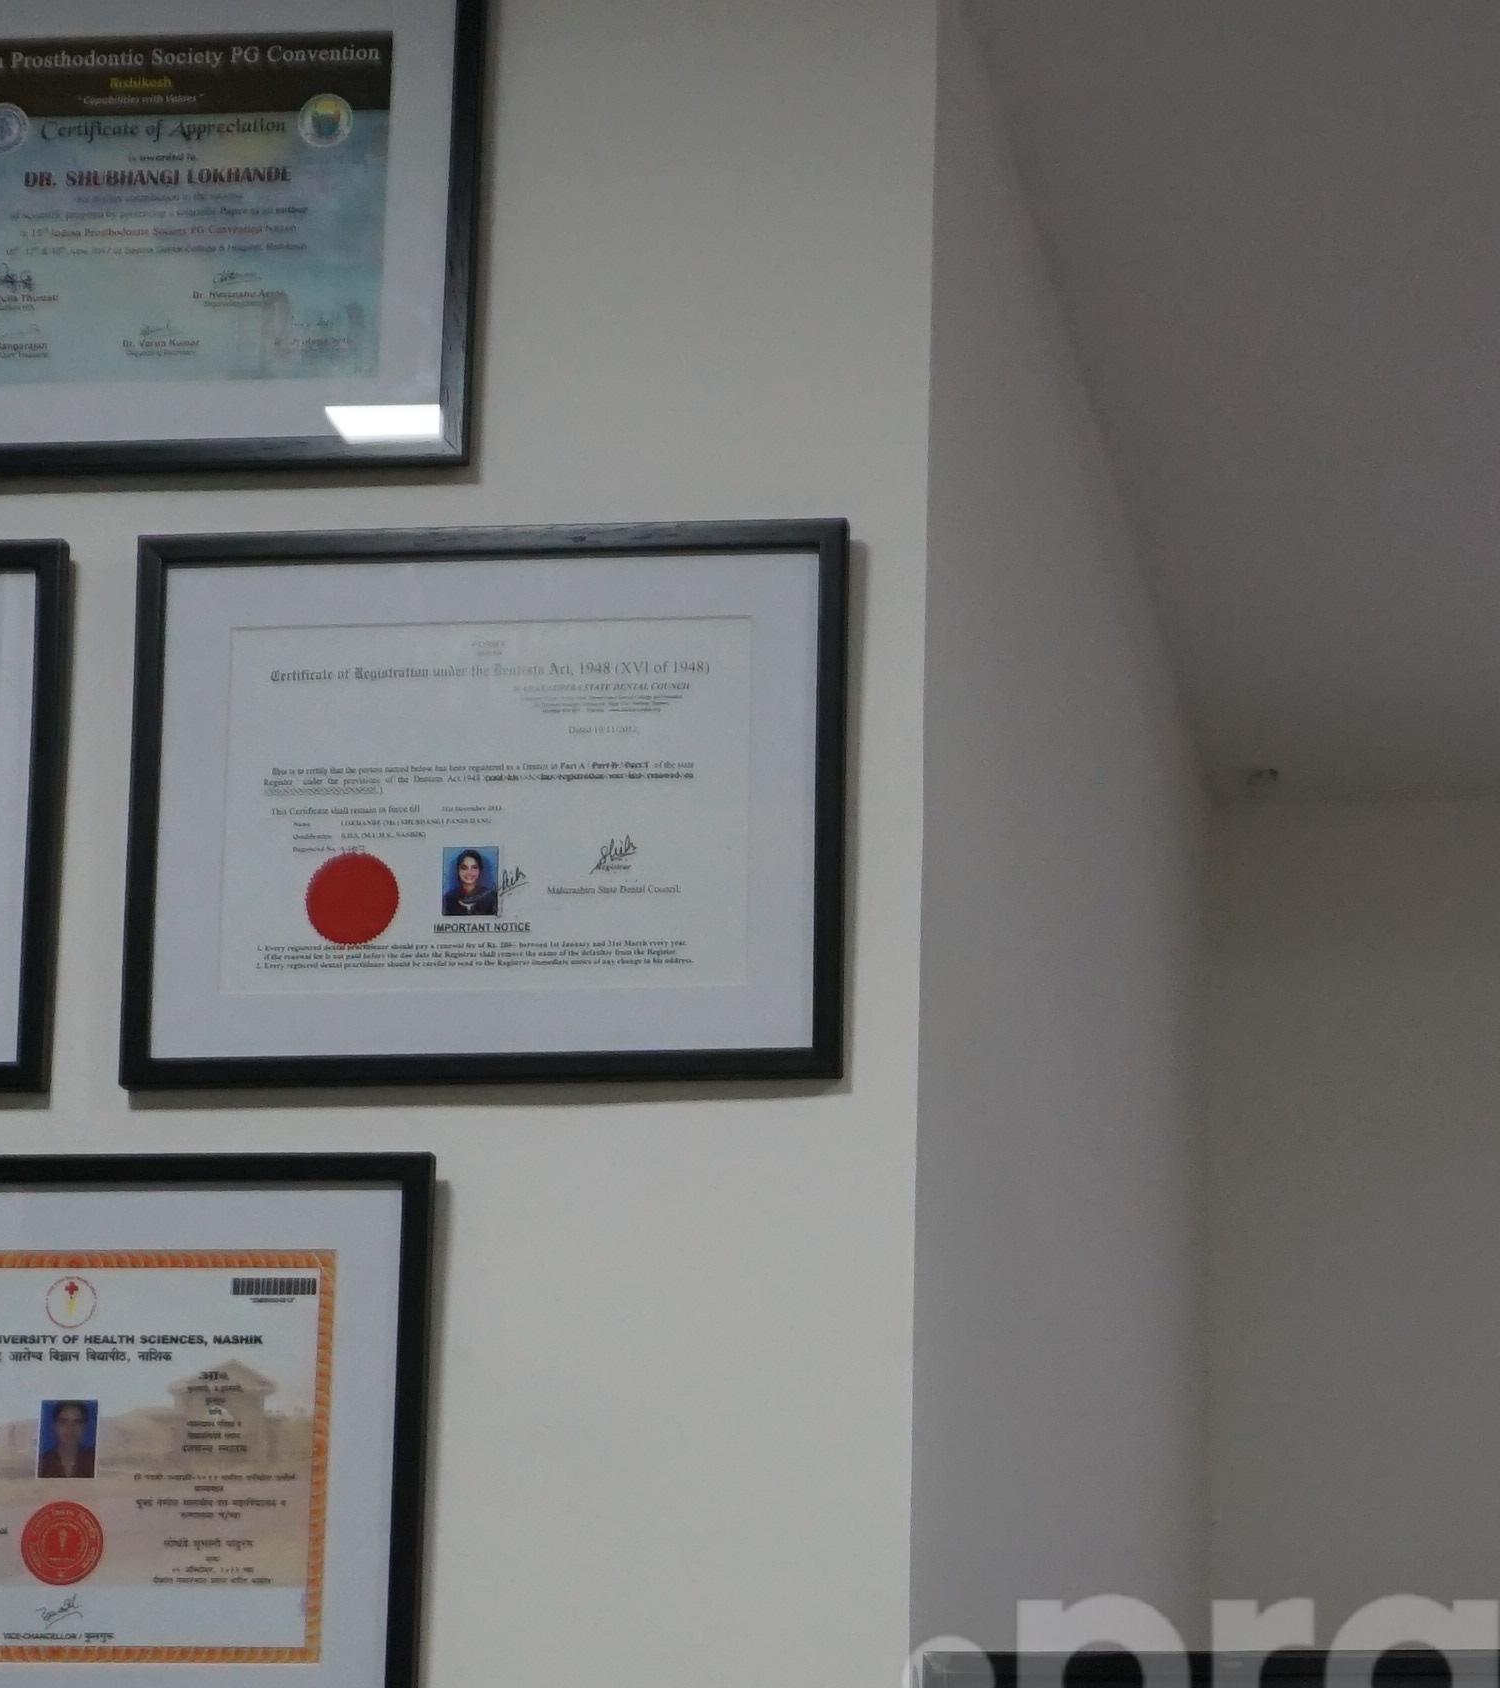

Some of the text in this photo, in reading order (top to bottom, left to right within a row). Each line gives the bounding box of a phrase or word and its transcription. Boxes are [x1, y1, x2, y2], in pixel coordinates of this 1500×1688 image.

[10, 48, 144, 70] Prosthodontic
[151, 47, 224, 69] Society
[230, 46, 260, 65] PG
[266, 44, 380, 63] Convention
[37, 116, 286, 144] Certificate of Appreciation
[433, 921, 531, 934] IMPORTANT NOTICE
[61, 1334, 80, 1345] OF
[83, 1334, 135, 1345] HEALTH
[139, 1334, 209, 1347] SCIENCES,
[212, 1334, 264, 1345] NASHIK
